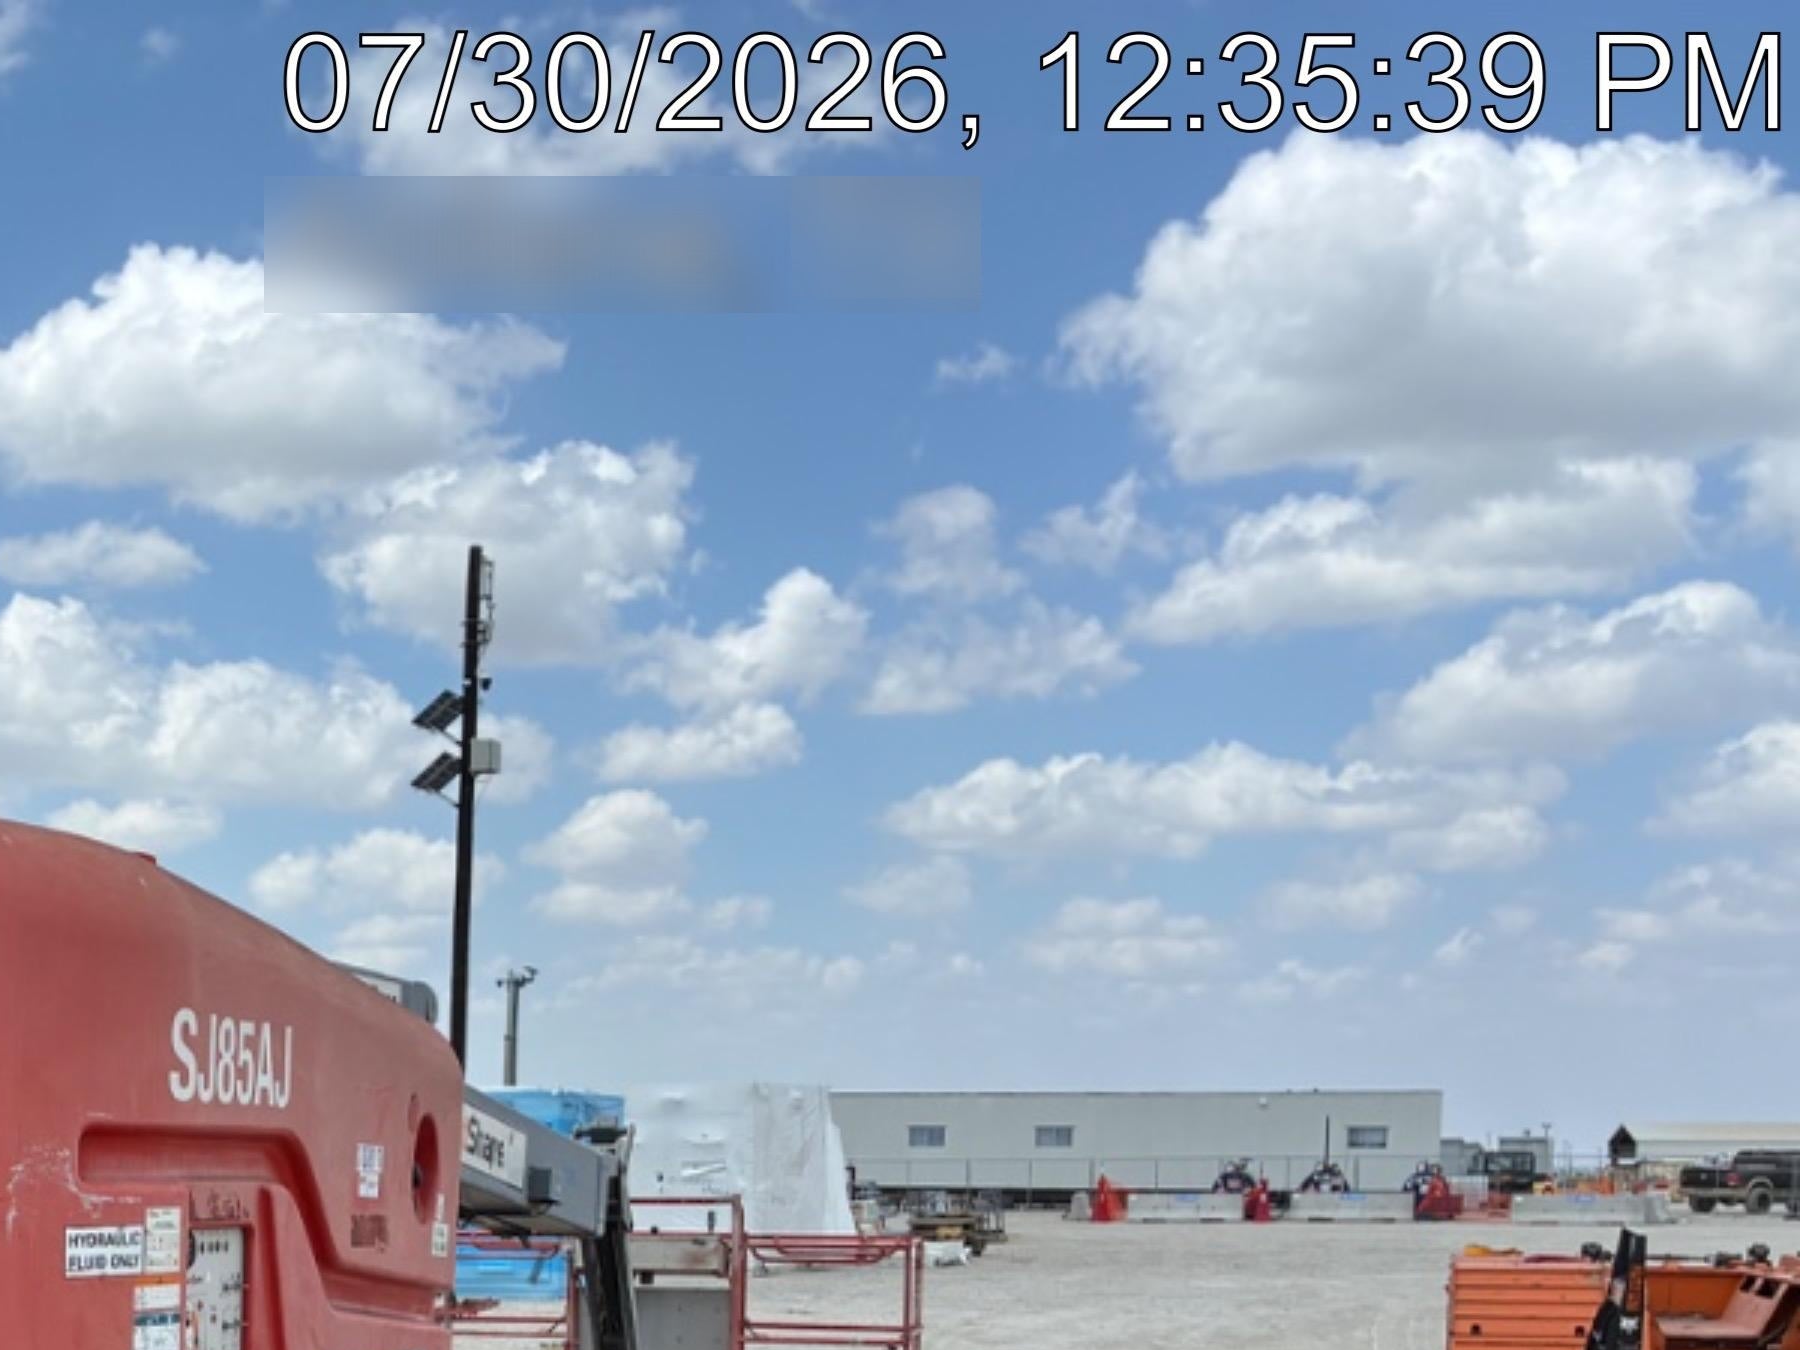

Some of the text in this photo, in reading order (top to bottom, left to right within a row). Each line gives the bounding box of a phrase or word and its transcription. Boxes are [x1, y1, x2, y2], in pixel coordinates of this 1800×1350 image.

[168, 1006, 293, 1109] SJ85AJ
[68, 1231, 141, 1249] HYDRAULIC
[68, 1253, 141, 1272] FLUID ONLY
